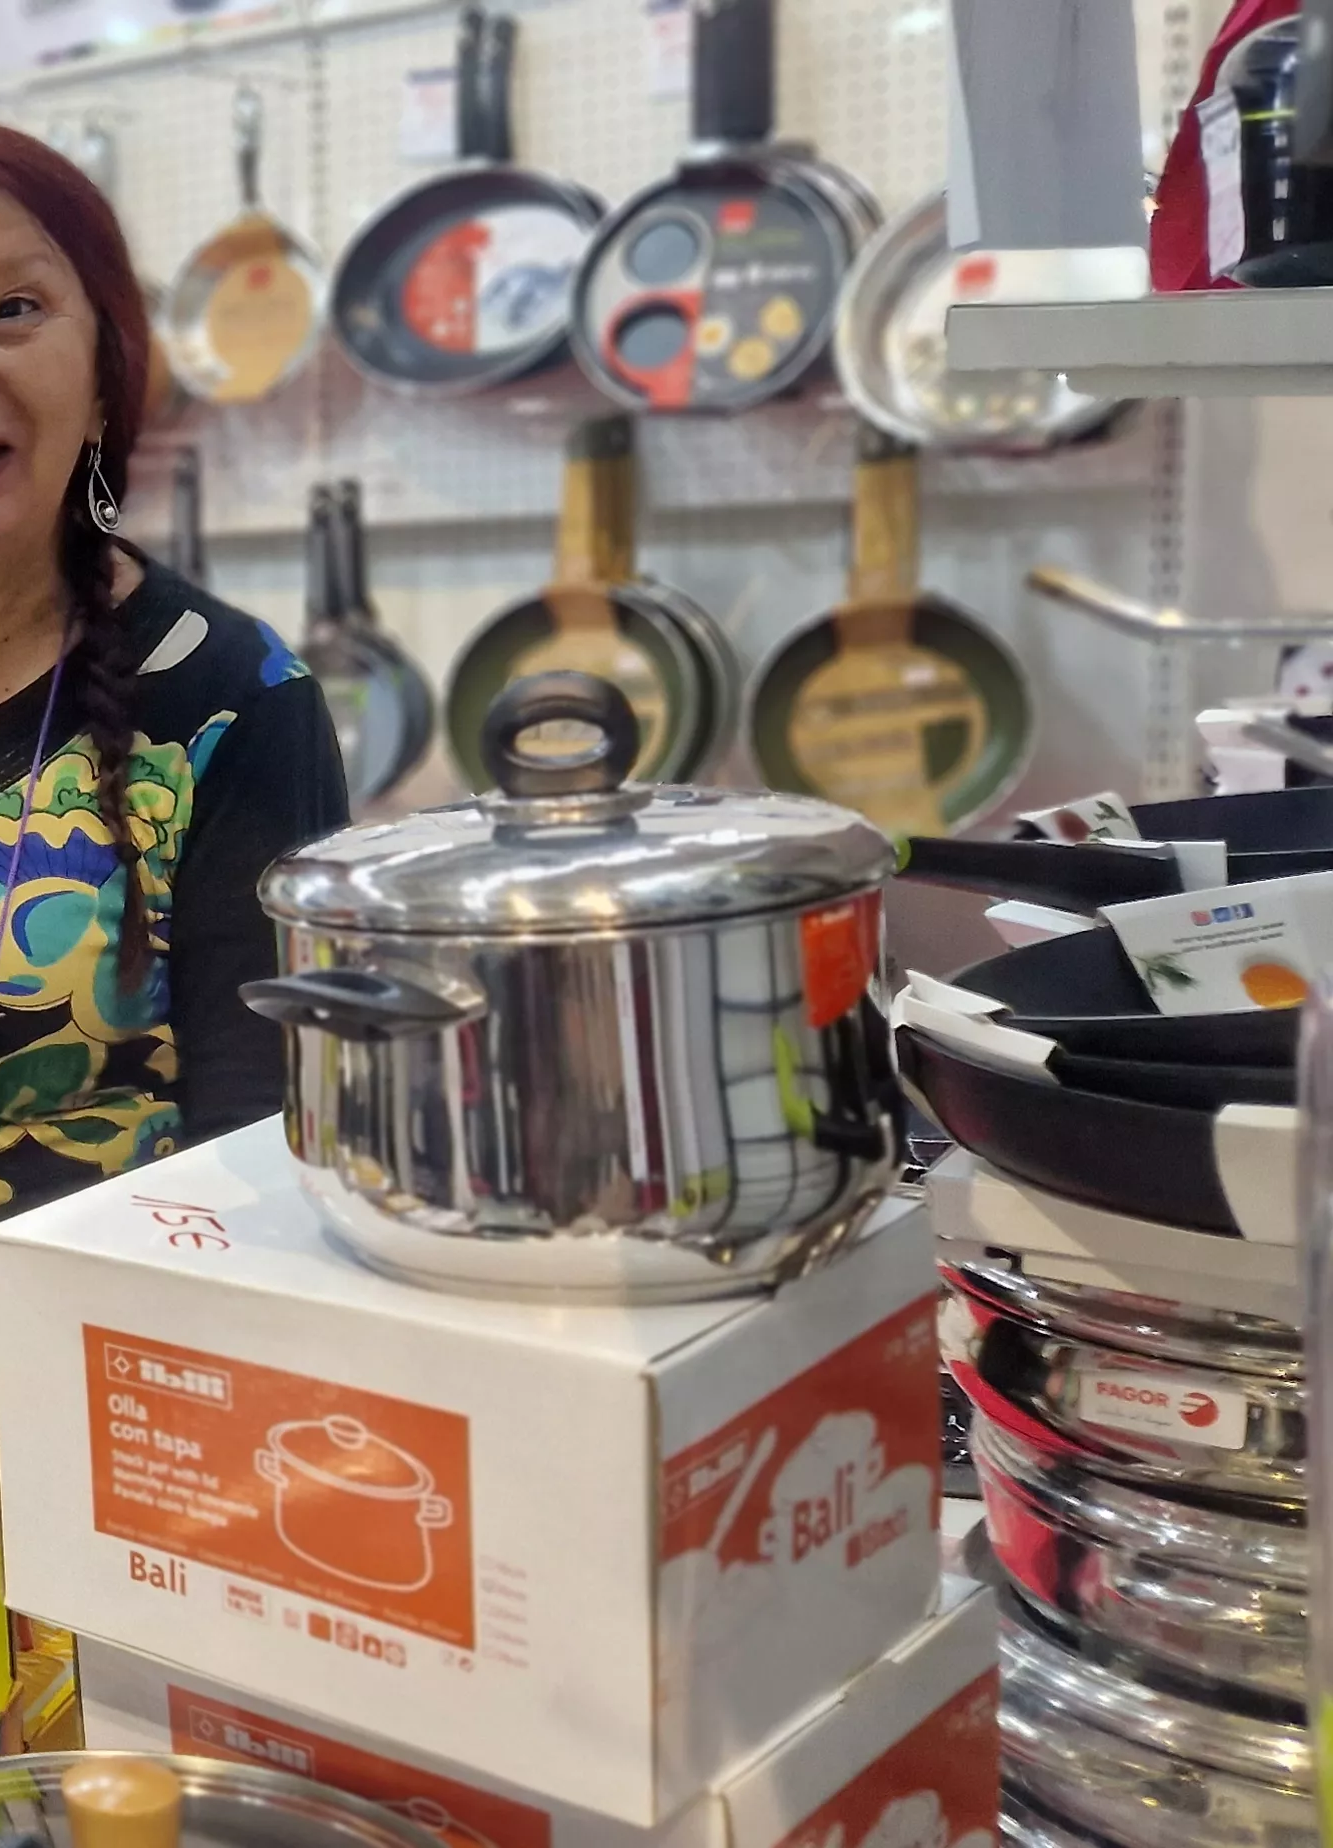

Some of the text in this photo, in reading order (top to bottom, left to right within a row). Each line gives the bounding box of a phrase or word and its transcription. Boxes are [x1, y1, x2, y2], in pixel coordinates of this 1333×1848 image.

[108, 1393, 148, 1422] Olla
[1096, 1381, 1170, 1408] FAGOR
[109, 1419, 202, 1461] con tapa
[792, 1461, 854, 1563] Bali
[129, 1550, 187, 1596] Bali
